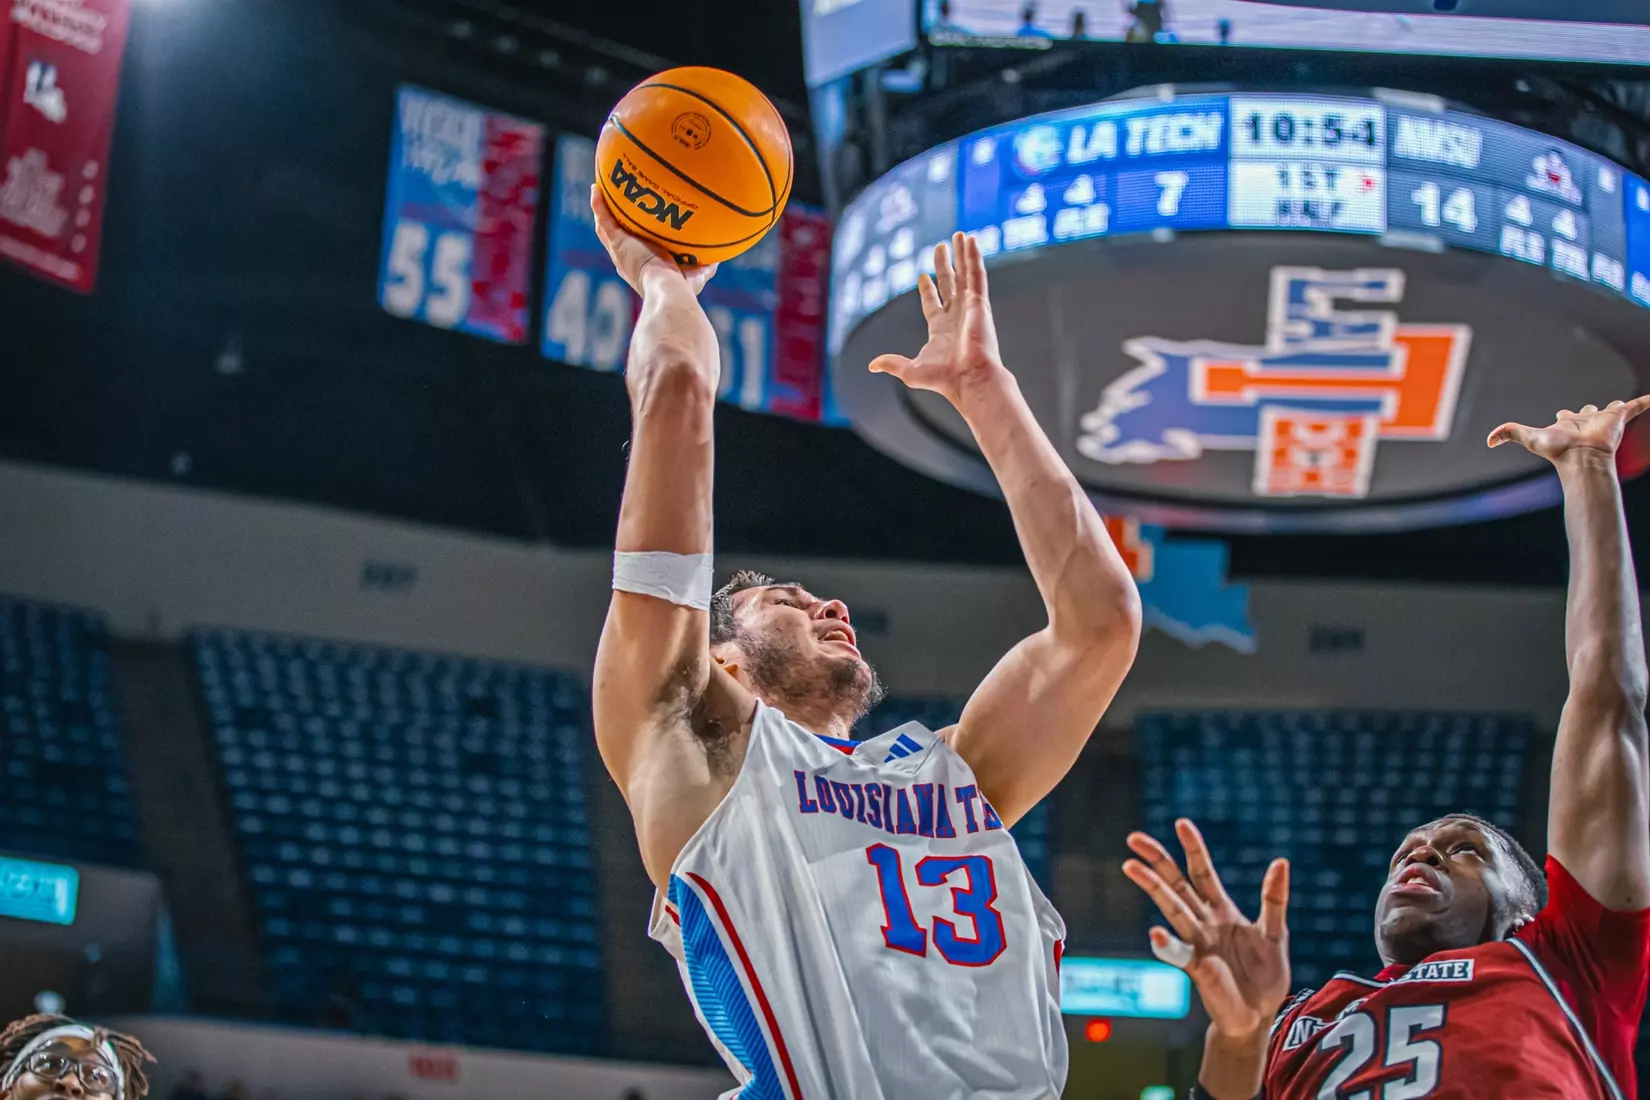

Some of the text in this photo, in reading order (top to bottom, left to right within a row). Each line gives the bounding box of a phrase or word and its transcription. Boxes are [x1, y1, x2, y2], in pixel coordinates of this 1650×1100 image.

[1067, 112, 1224, 164] LA TECH
[1246, 111, 1376, 147] 10:54
[610, 158, 694, 231] NCAA
[622, 152, 699, 210] OFFICIAL GAME BALL
[1154, 171, 1189, 216] 7
[1277, 168, 1340, 191] 1ST
[1411, 181, 1478, 233] 14
[382, 221, 471, 329] 55
[794, 770, 957, 839] LOUISIANA
[865, 842, 1007, 967] 13
[1315, 1002, 1447, 1100] 25
